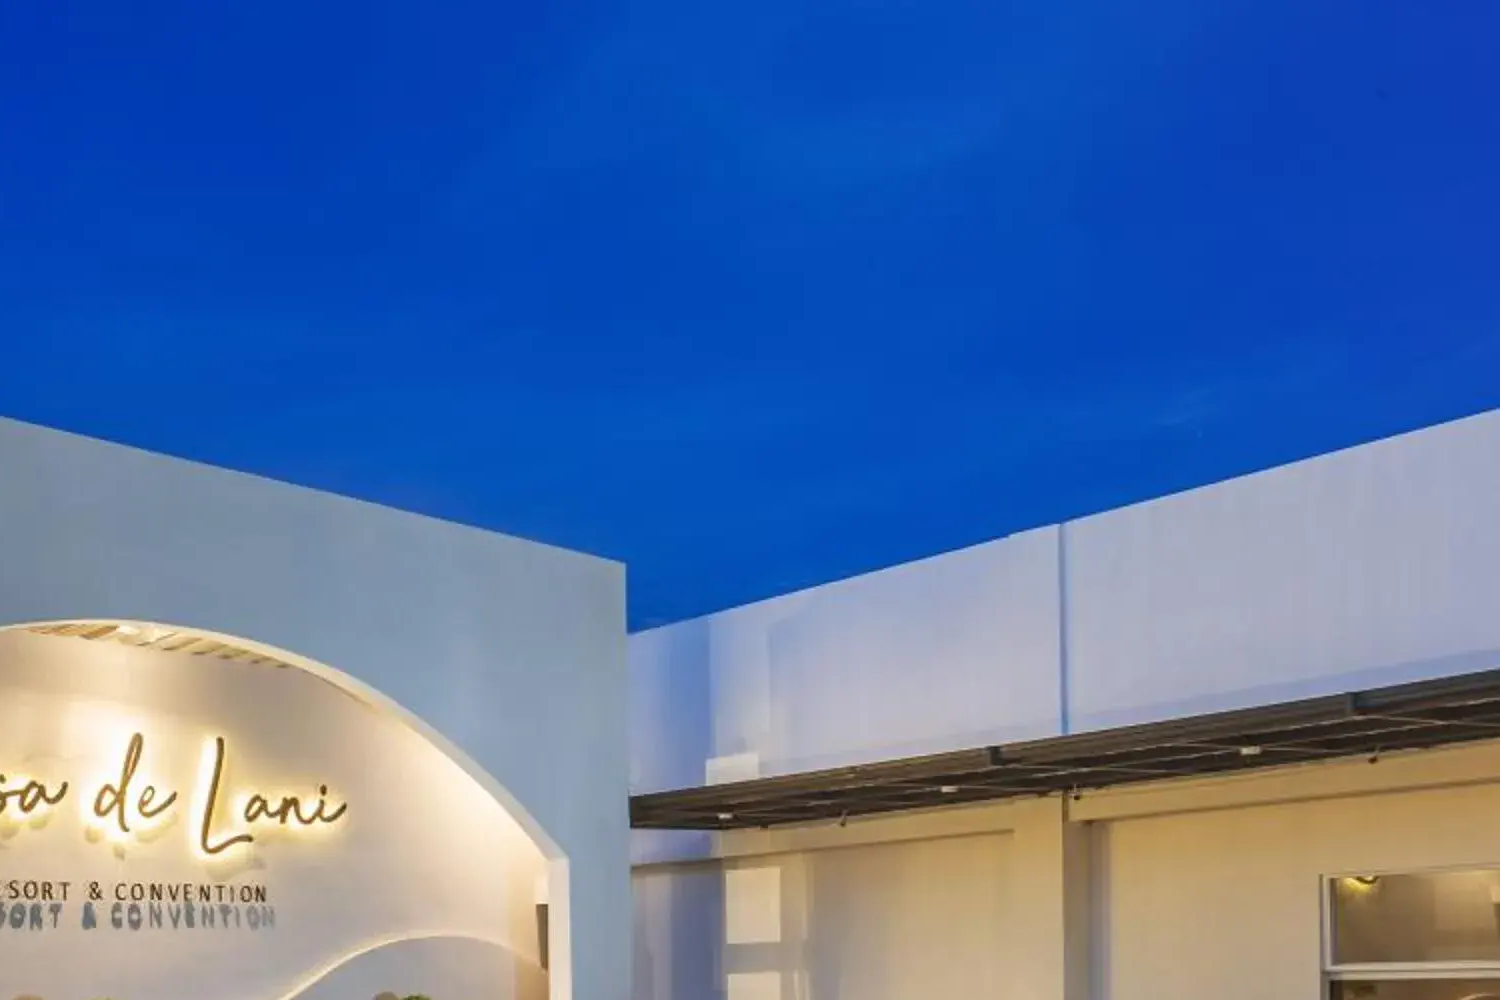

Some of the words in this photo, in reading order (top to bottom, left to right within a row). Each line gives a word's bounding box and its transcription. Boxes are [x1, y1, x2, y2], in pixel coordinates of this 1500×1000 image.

[94, 732, 177, 832] de
[201, 737, 347, 854] Lani
[88, 881, 103, 901] &
[114, 882, 268, 903] CONVENTION
